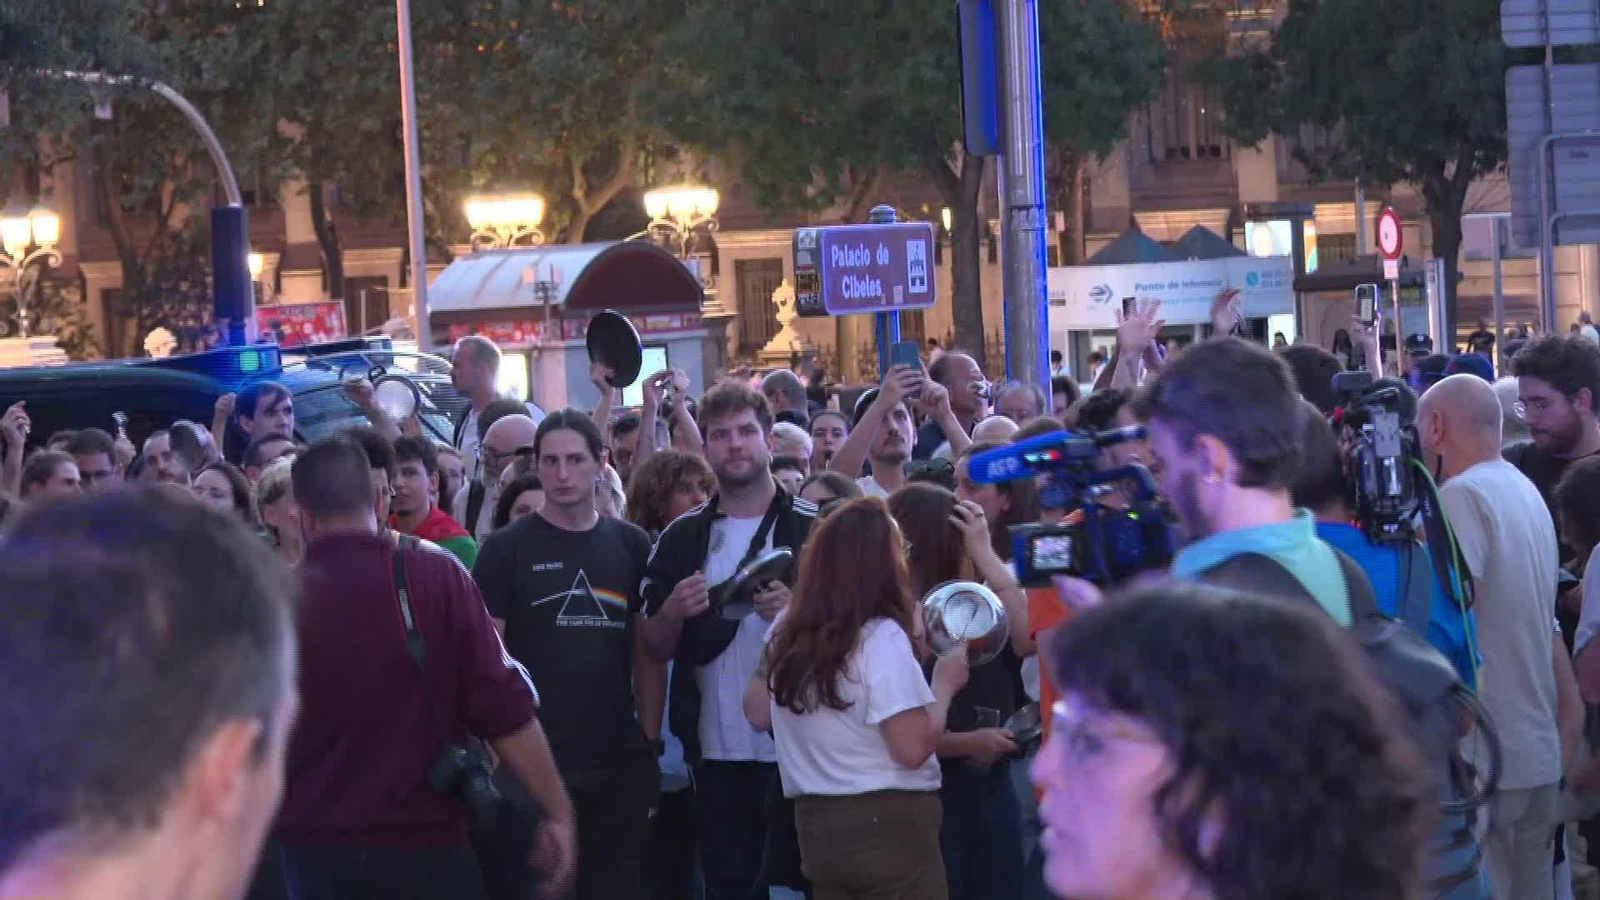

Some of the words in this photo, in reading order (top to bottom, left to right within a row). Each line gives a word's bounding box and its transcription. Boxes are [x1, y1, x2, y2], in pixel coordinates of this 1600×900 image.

[832, 244, 870, 267] Palacio
[876, 242, 889, 266] de
[842, 275, 882, 299] Cibeles
[1135, 281, 1164, 292] Punto
[1167, 280, 1180, 289] de
